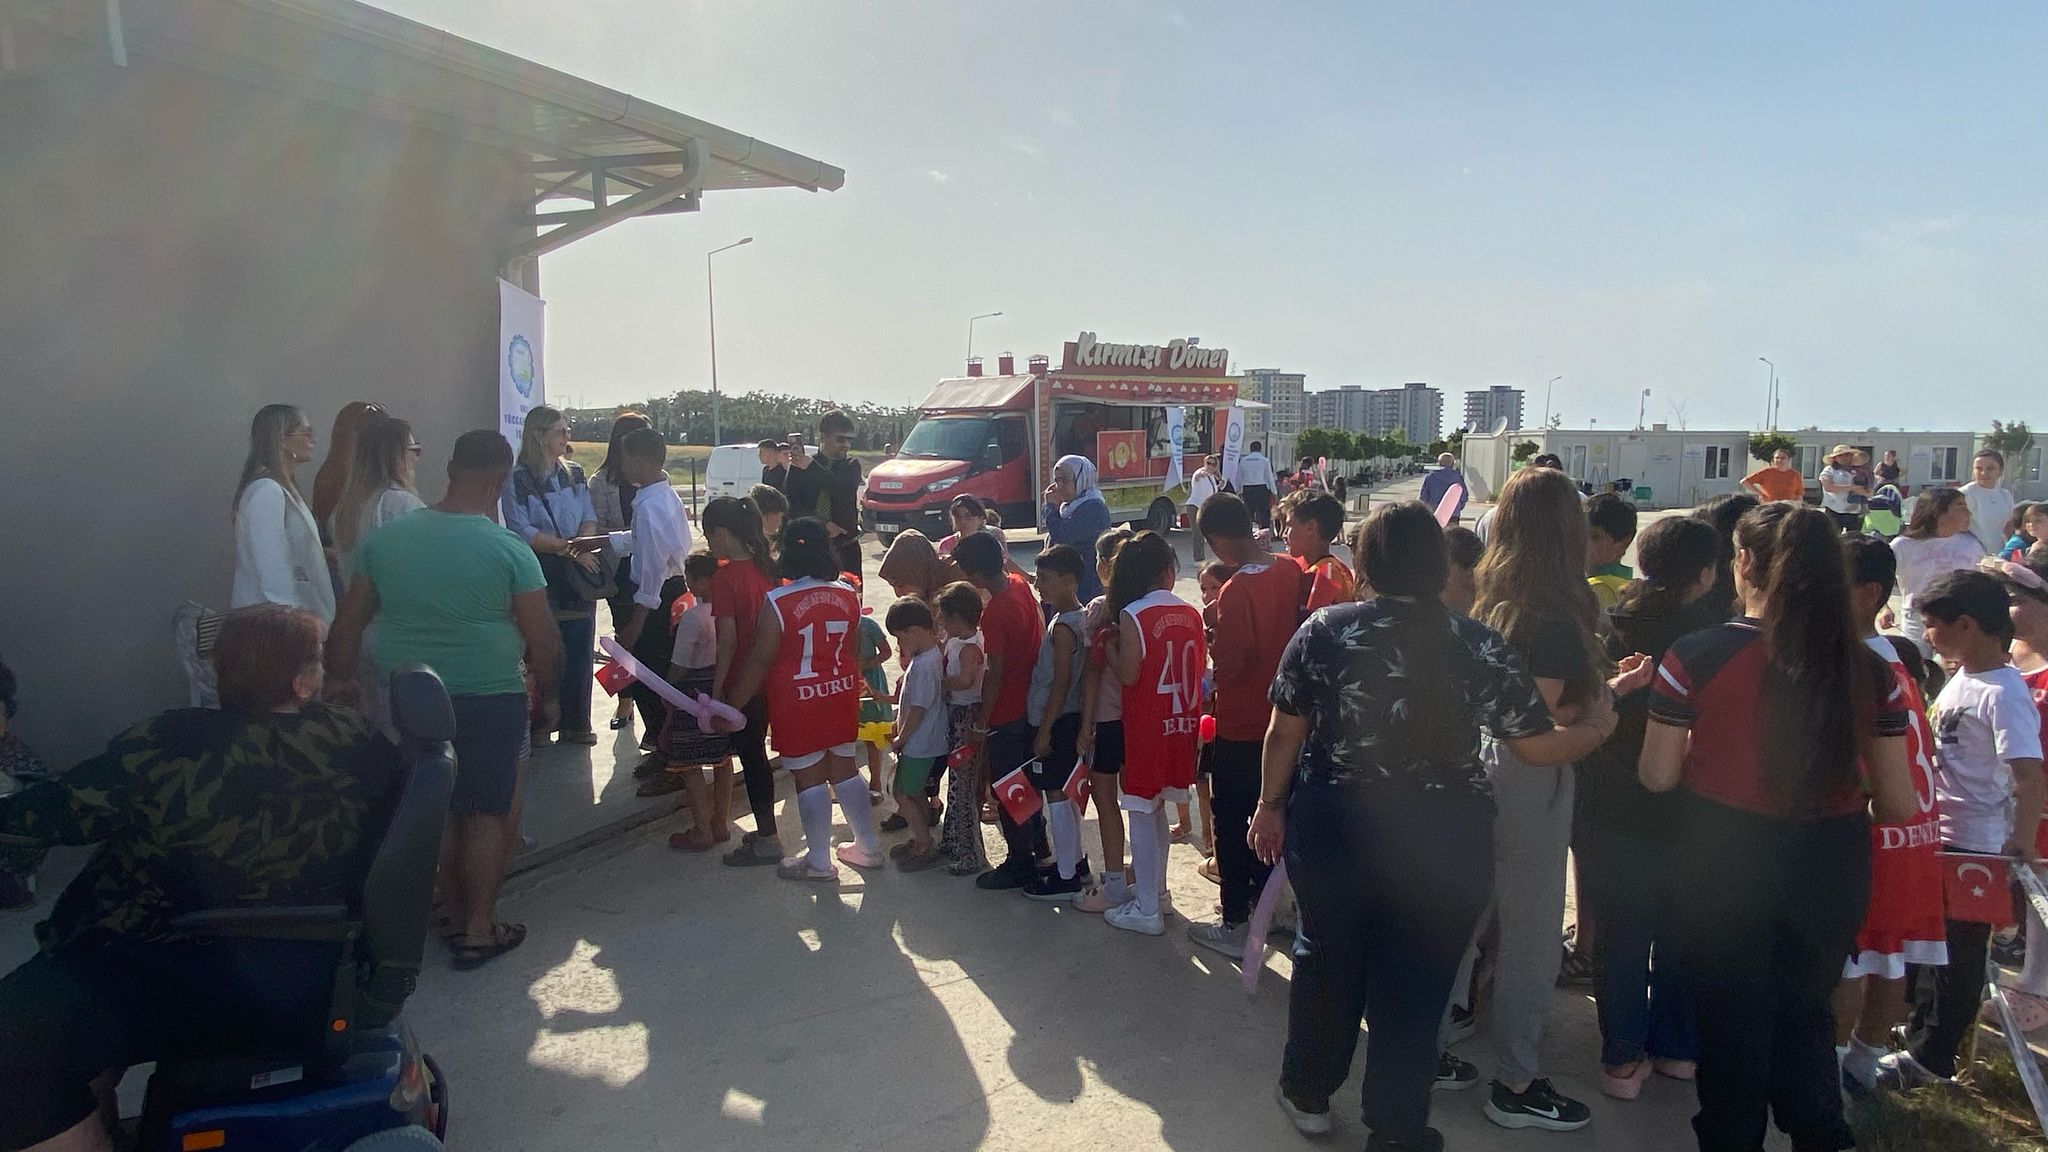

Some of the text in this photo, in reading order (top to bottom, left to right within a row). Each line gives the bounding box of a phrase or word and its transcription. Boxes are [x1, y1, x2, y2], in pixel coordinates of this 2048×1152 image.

[1076, 331, 1229, 370] Kırmızı Döner
[793, 620, 850, 680] 17
[797, 675, 854, 701] DURU
[1156, 639, 1198, 714] 40
